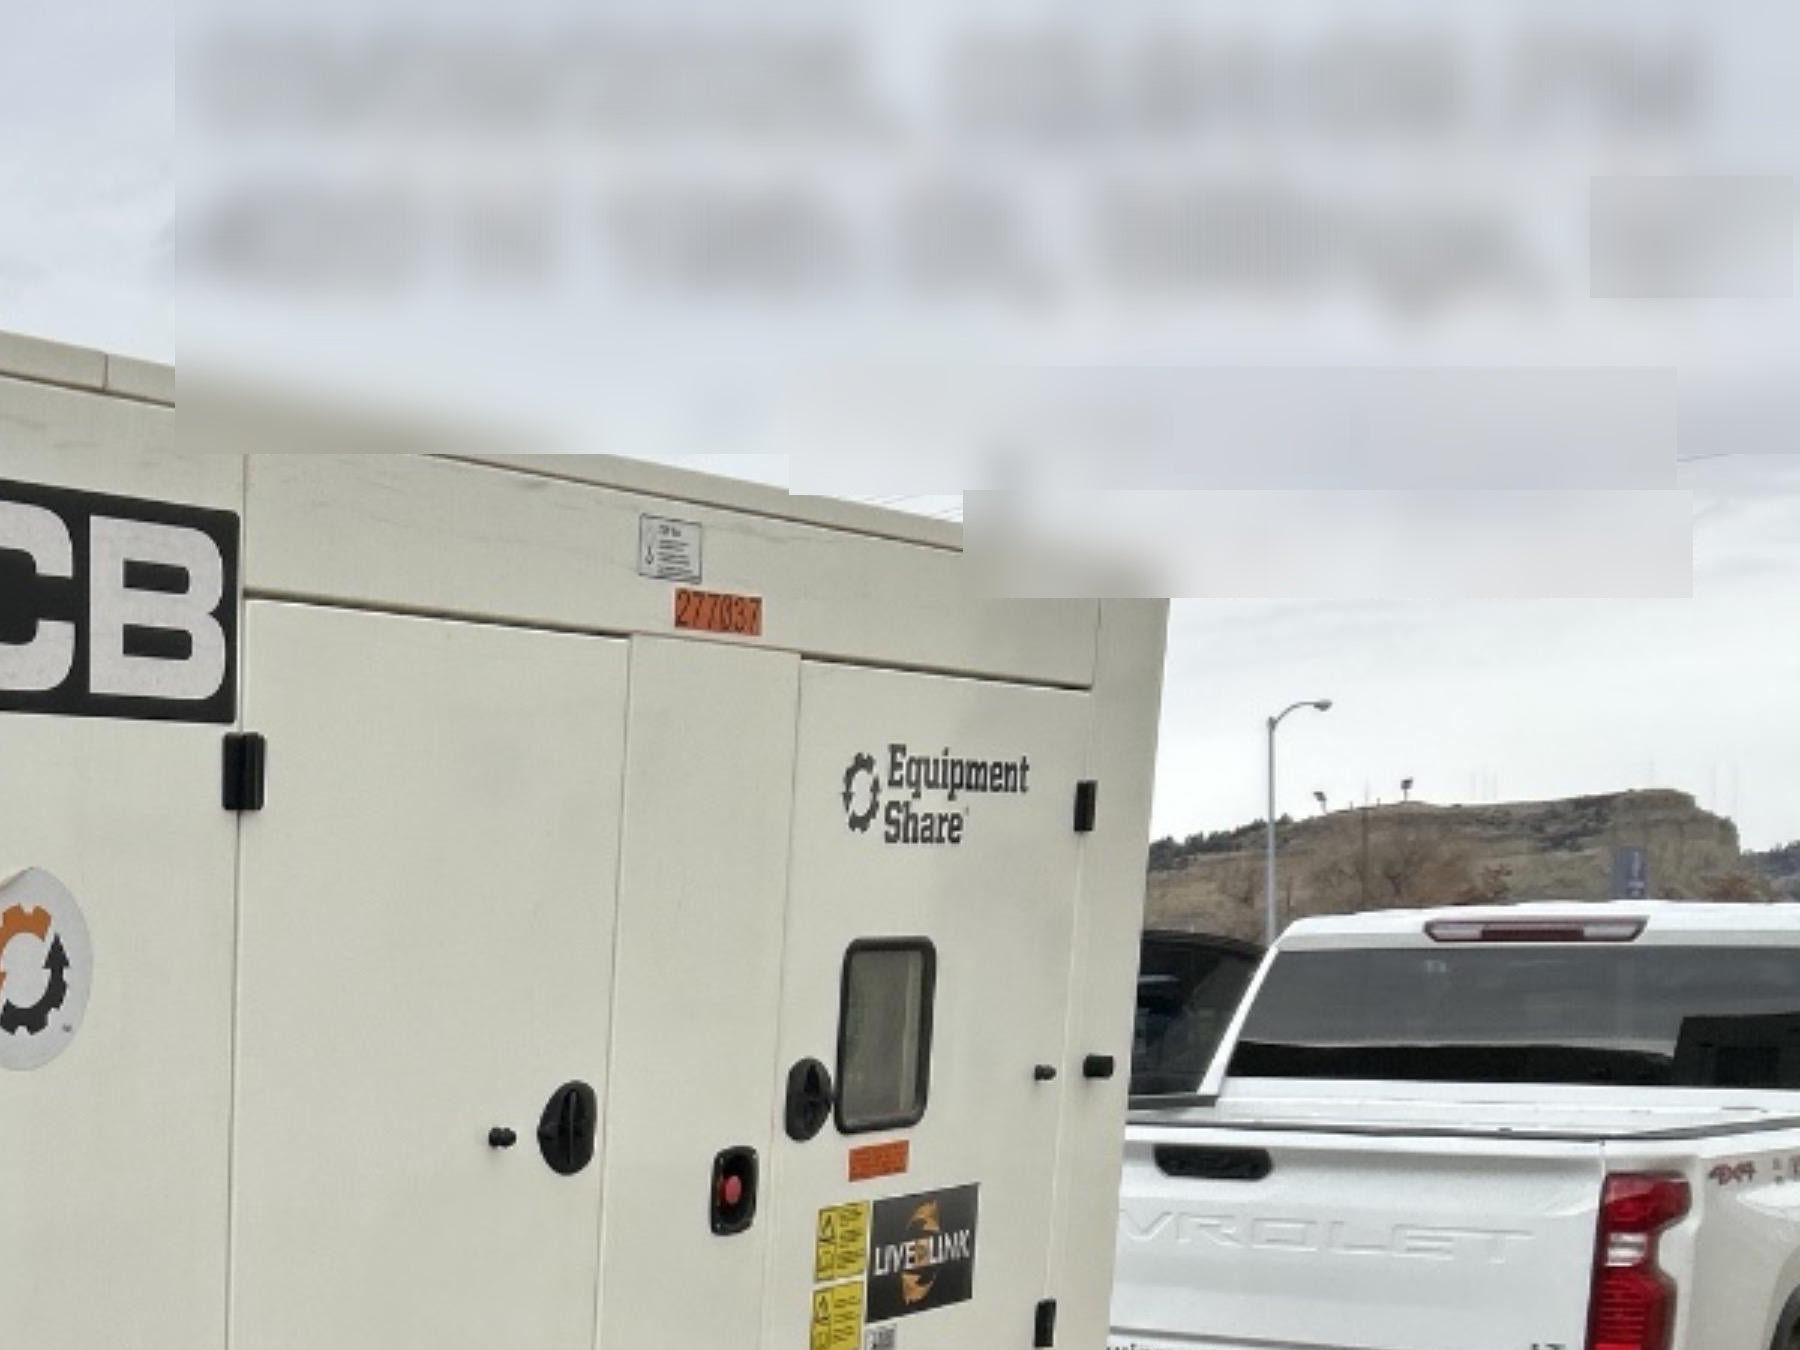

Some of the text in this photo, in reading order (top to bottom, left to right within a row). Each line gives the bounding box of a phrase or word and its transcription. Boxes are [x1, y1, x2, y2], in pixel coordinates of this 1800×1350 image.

[677, 589, 761, 637] 277037
[887, 743, 1030, 801] Equipment
[884, 800, 964, 844] Share
